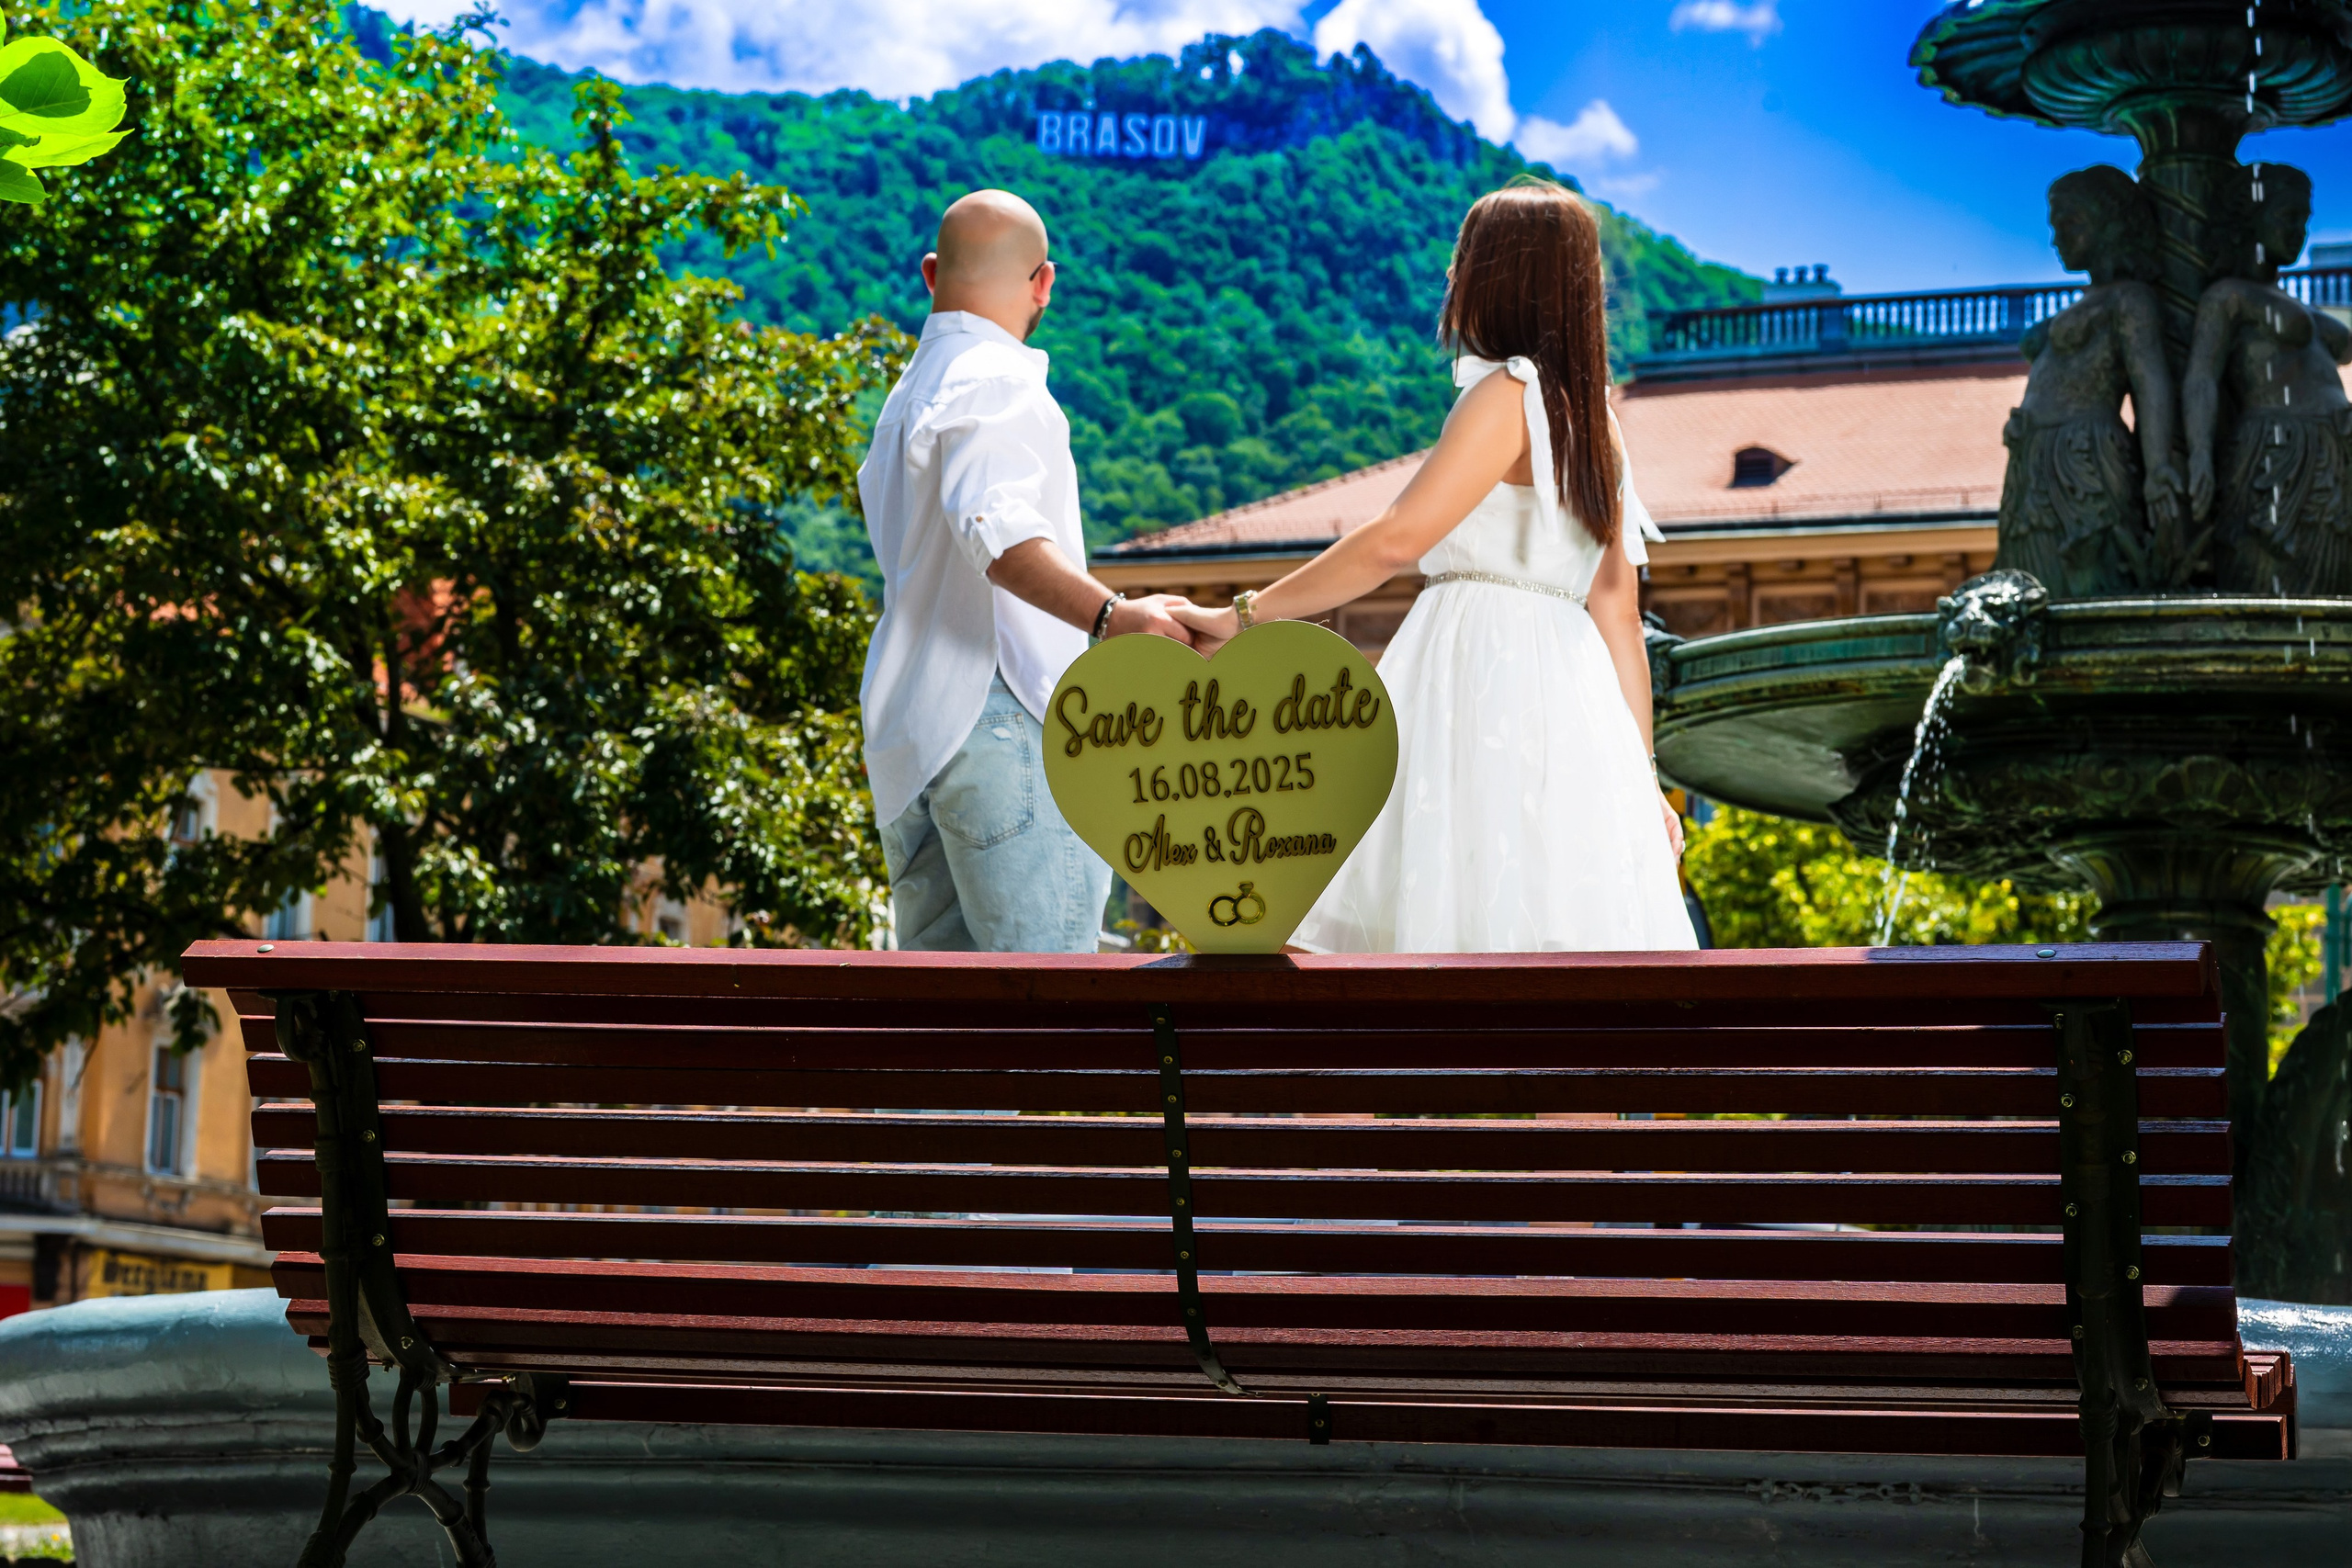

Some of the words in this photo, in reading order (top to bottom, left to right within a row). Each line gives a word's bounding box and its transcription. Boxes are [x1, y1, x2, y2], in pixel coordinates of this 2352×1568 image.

[1039, 112, 1205, 158] BRASOV
[1056, 686, 1163, 758] Save
[1179, 679, 1256, 741] the
[1273, 667, 1379, 735] date
[1128, 752, 1315, 804] 16.08.2025
[1125, 814, 1198, 874] Alex
[1204, 826, 1226, 863] &
[1227, 807, 1337, 865] Roxana
